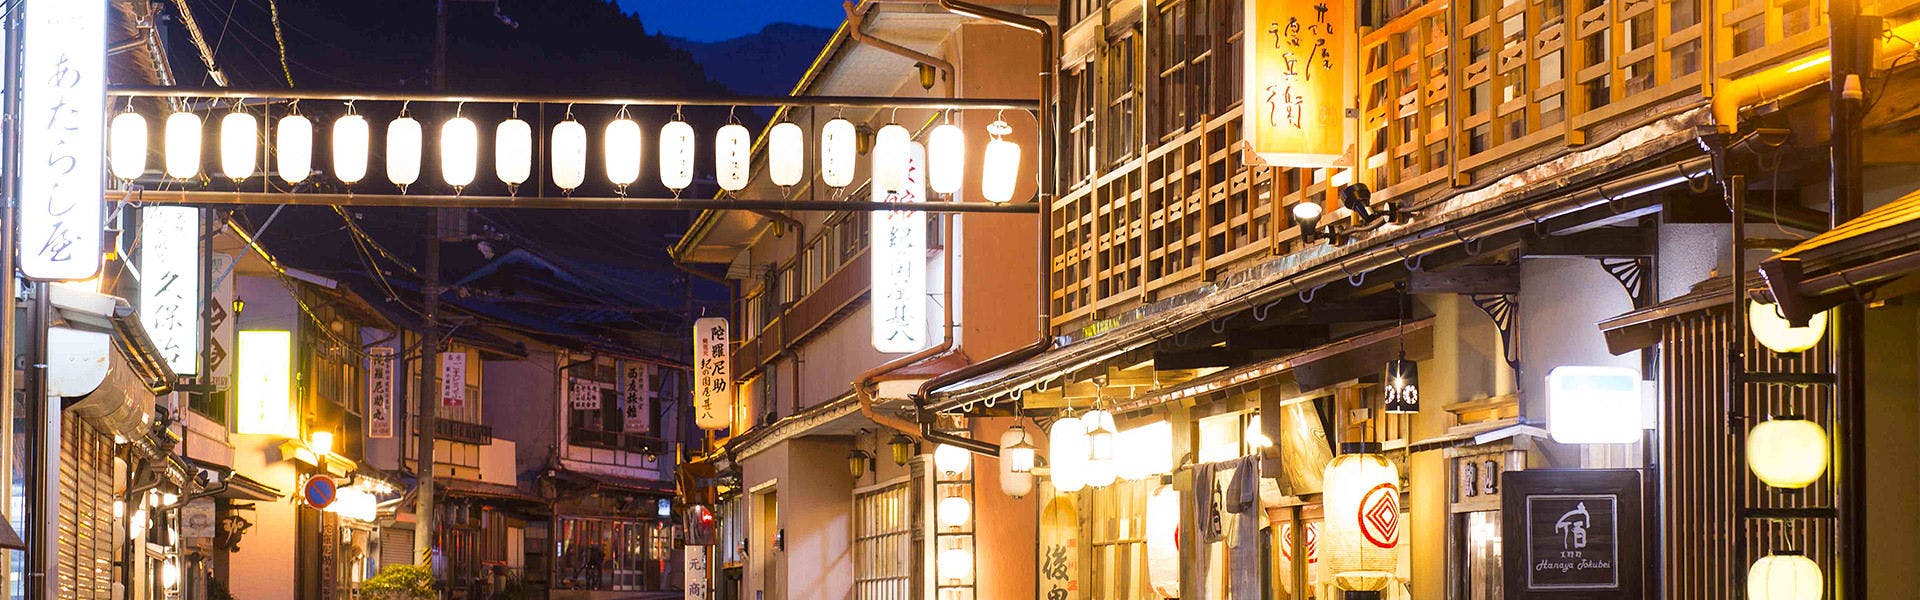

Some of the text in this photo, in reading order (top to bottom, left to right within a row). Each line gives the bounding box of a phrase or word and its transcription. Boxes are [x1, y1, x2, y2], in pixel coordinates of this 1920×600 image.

[38, 52, 83, 262] あたらし屋
[711, 325, 727, 394] 陀羅尼助
[1535, 558, 1611, 573] Hanaya Tokubei
